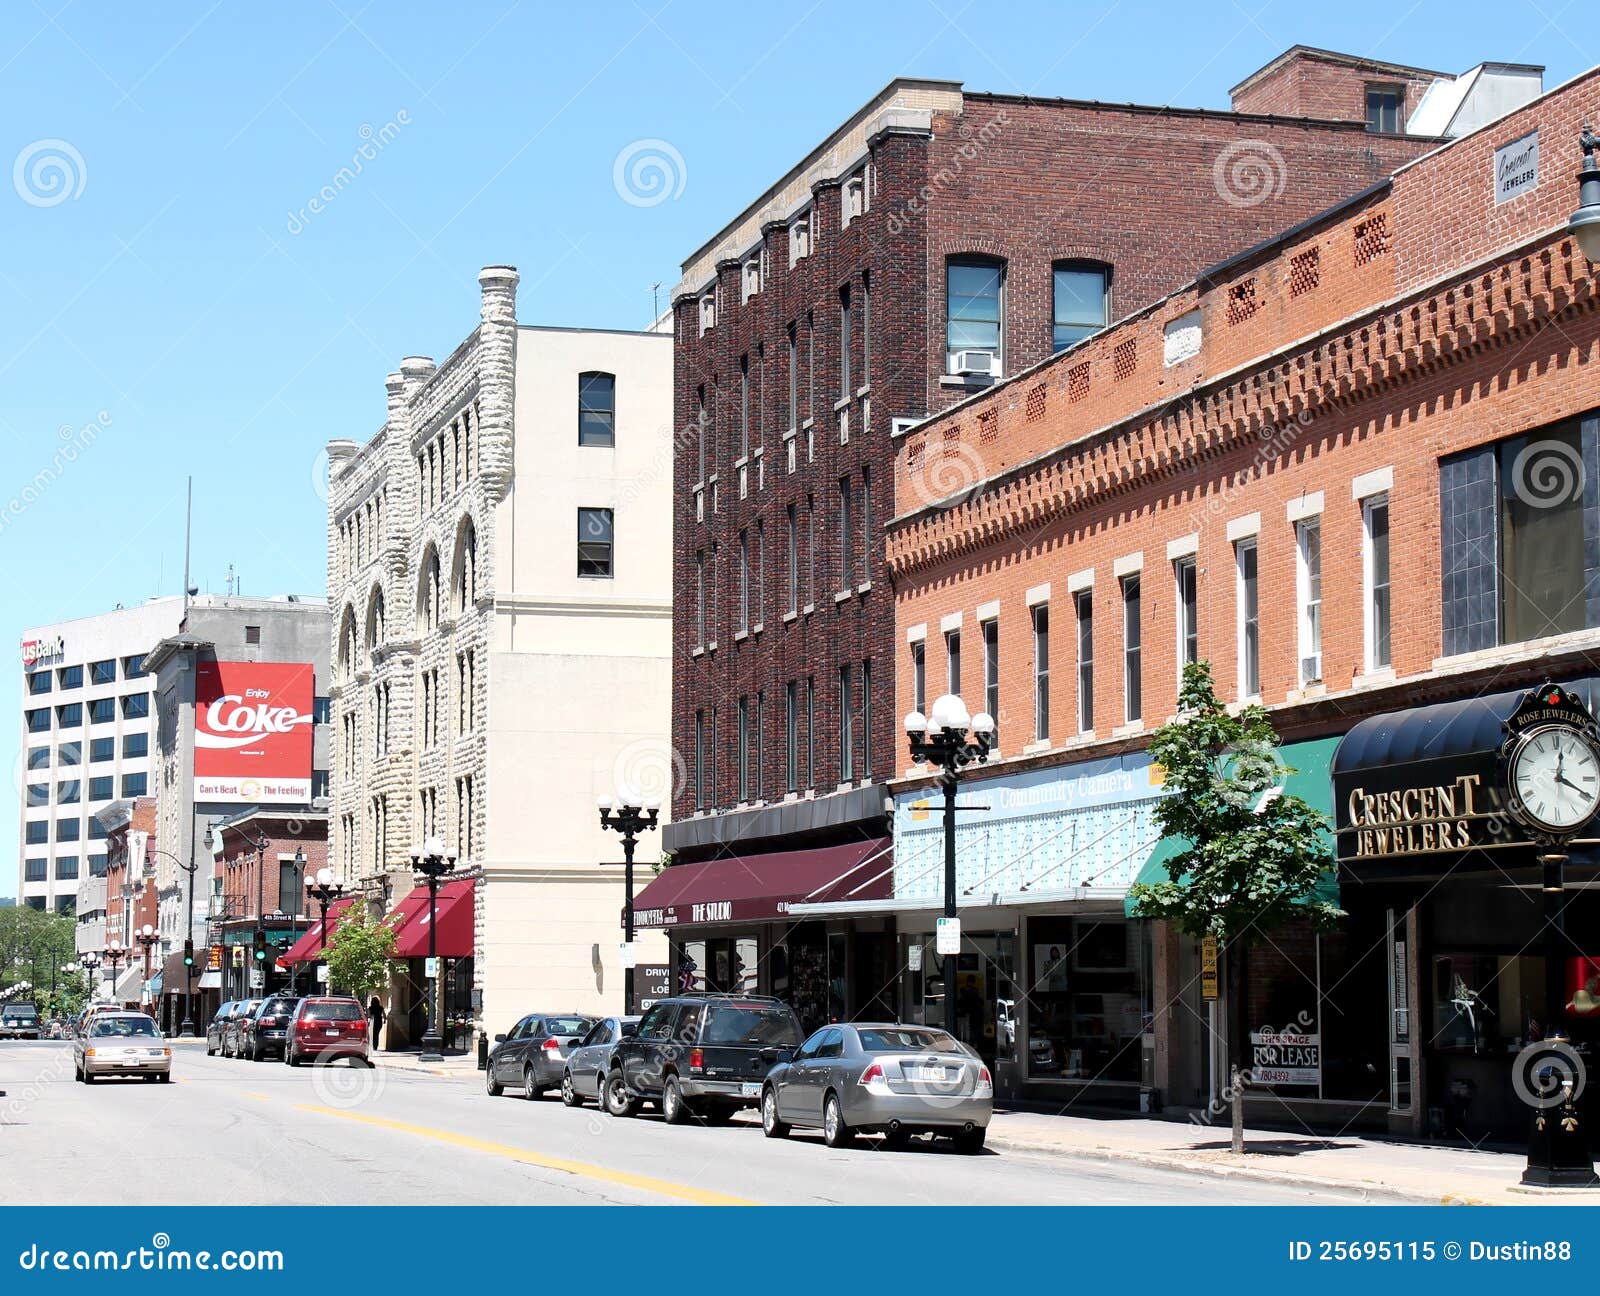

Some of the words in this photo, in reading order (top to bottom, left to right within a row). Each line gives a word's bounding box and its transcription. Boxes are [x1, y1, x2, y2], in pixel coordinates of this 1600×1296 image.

[1499, 145, 1534, 181] Crescent
[1503, 169, 1534, 192] JEWELERS
[245, 688, 270, 699] Enjoy
[206, 694, 298, 733] Coke
[1517, 711, 1540, 726] ROSE
[1542, 709, 1587, 726] JEWELERS
[200, 784, 219, 794] Can't
[264, 786, 276, 795] The
[1000, 778, 1075, 809] Community
[1078, 773, 1133, 797] Camera
[1349, 774, 1480, 828] CRESCENT
[1357, 820, 1470, 856] JEWELERS
[692, 904, 706, 922] THE
[707, 901, 732, 921] STUDIO
[1253, 1046, 1278, 1066] FOR
[1281, 1047, 1318, 1066] LEASE
